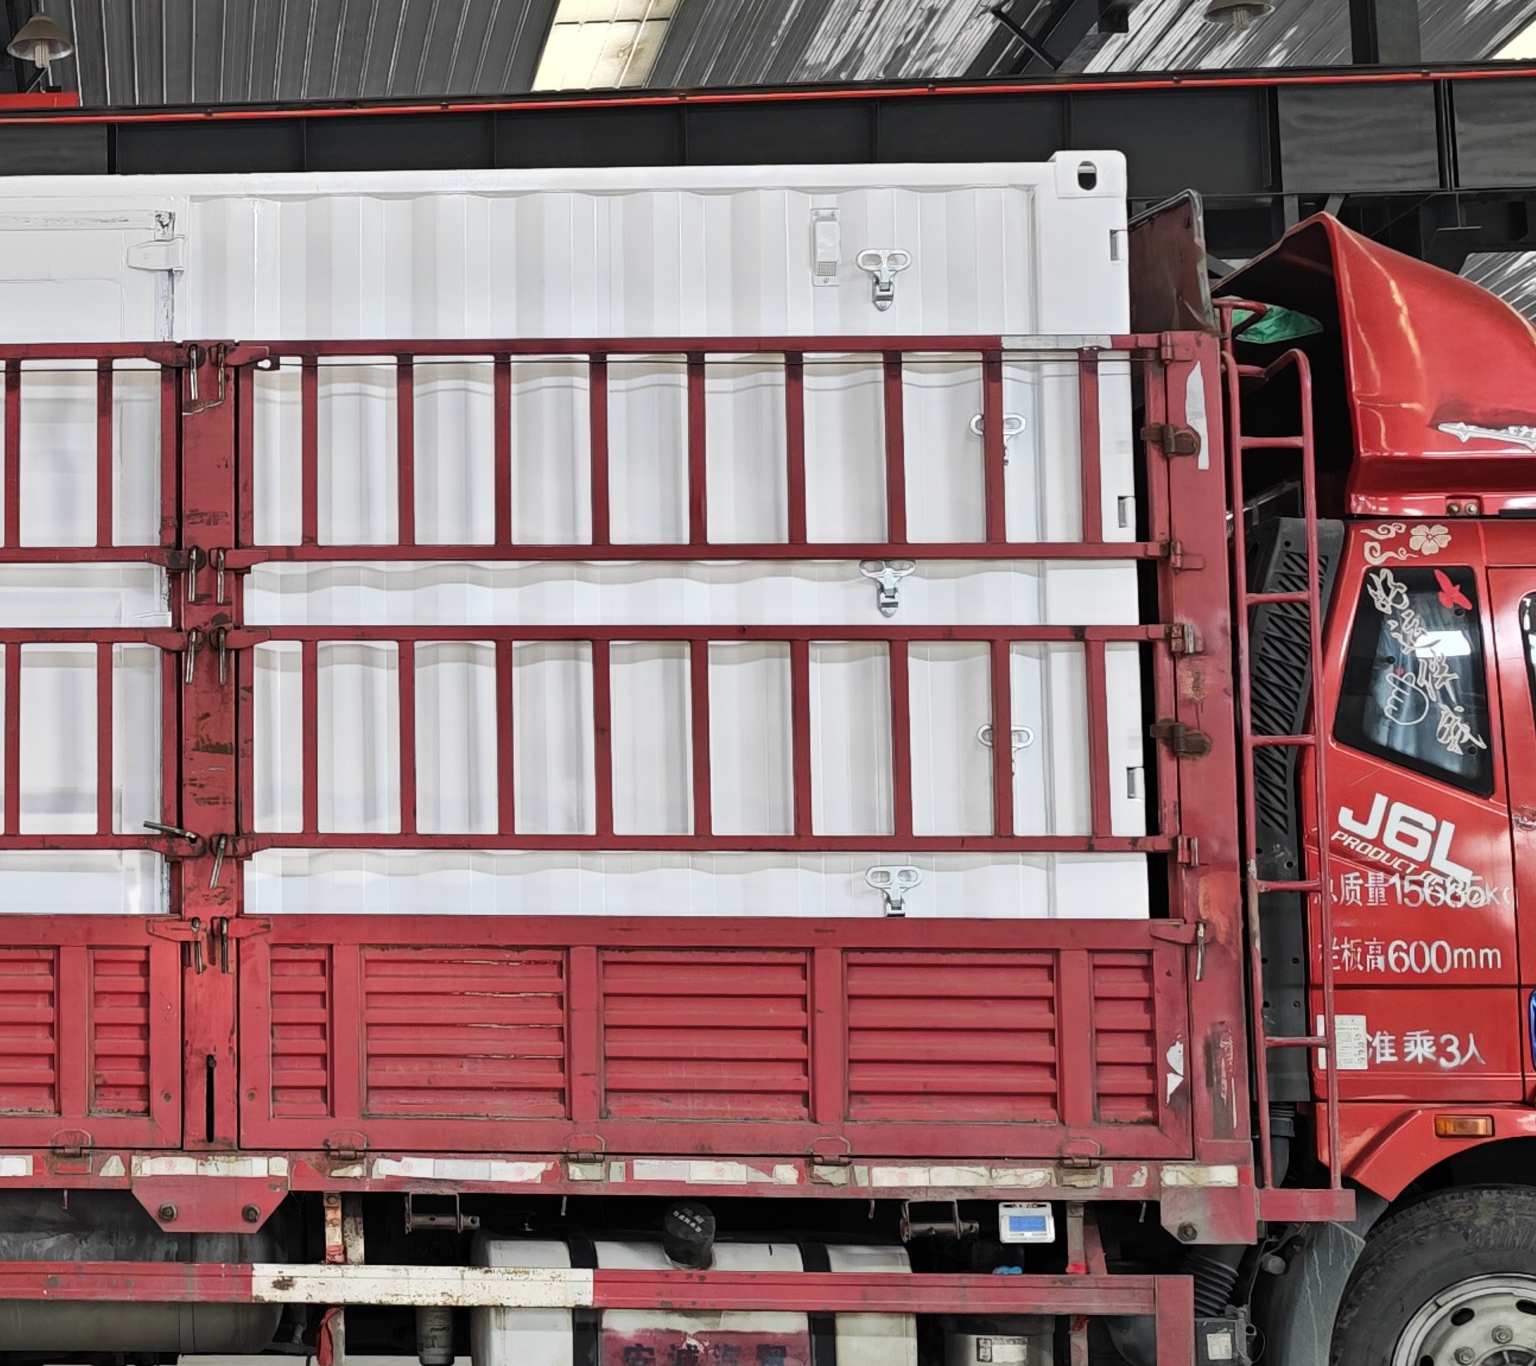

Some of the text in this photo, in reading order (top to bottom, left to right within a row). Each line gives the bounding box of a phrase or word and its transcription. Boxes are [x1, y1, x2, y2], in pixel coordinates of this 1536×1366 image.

[1330, 830, 1420, 875] PRODUCT
[1337, 792, 1473, 882] J6L
[1365, 1029, 1486, 1068] 准乘3人
